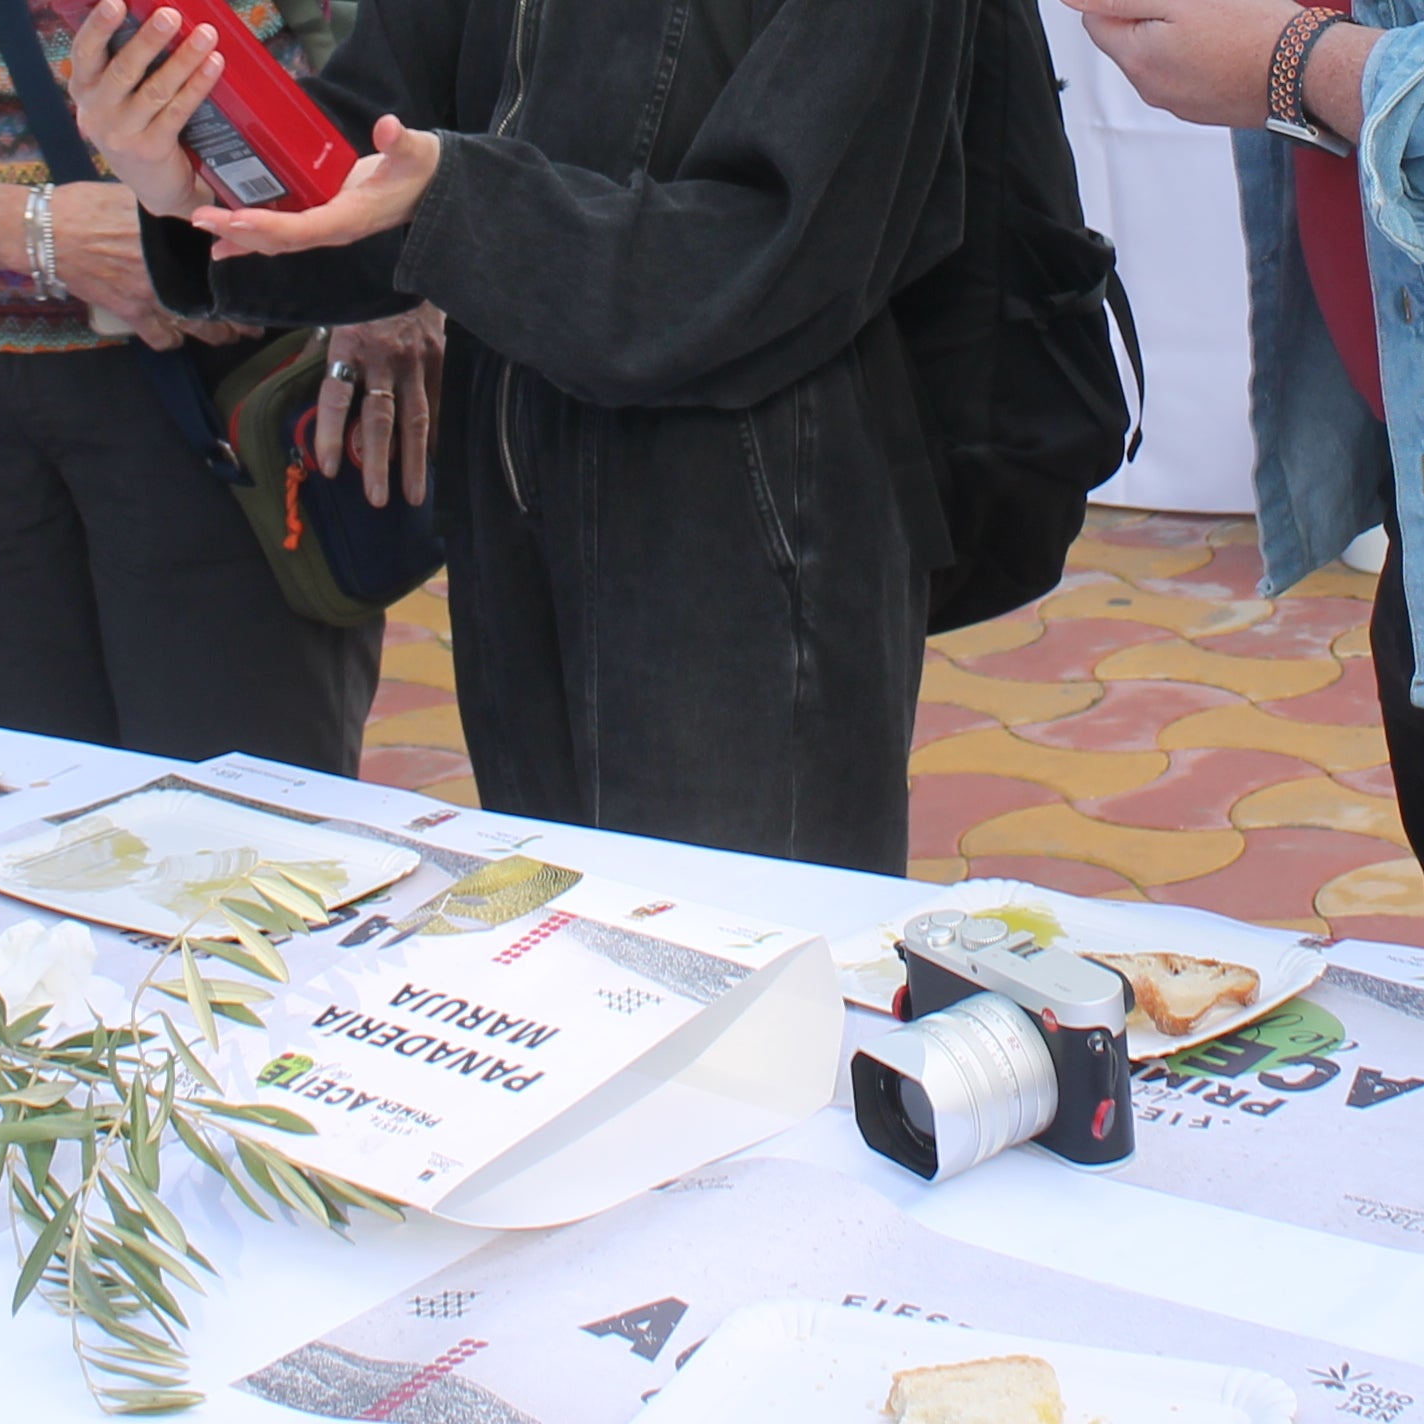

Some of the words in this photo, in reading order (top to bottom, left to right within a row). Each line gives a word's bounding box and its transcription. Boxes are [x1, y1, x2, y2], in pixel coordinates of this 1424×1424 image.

[388, 981, 561, 1050] MARUJA
[311, 1004, 546, 1093] PANADERÍA
[255, 1062, 380, 1112] ACEITE
[375, 1098, 443, 1129] PRIMER
[1131, 1101, 1213, 1130] FIE
[1356, 1382, 1415, 1405] OLEO
